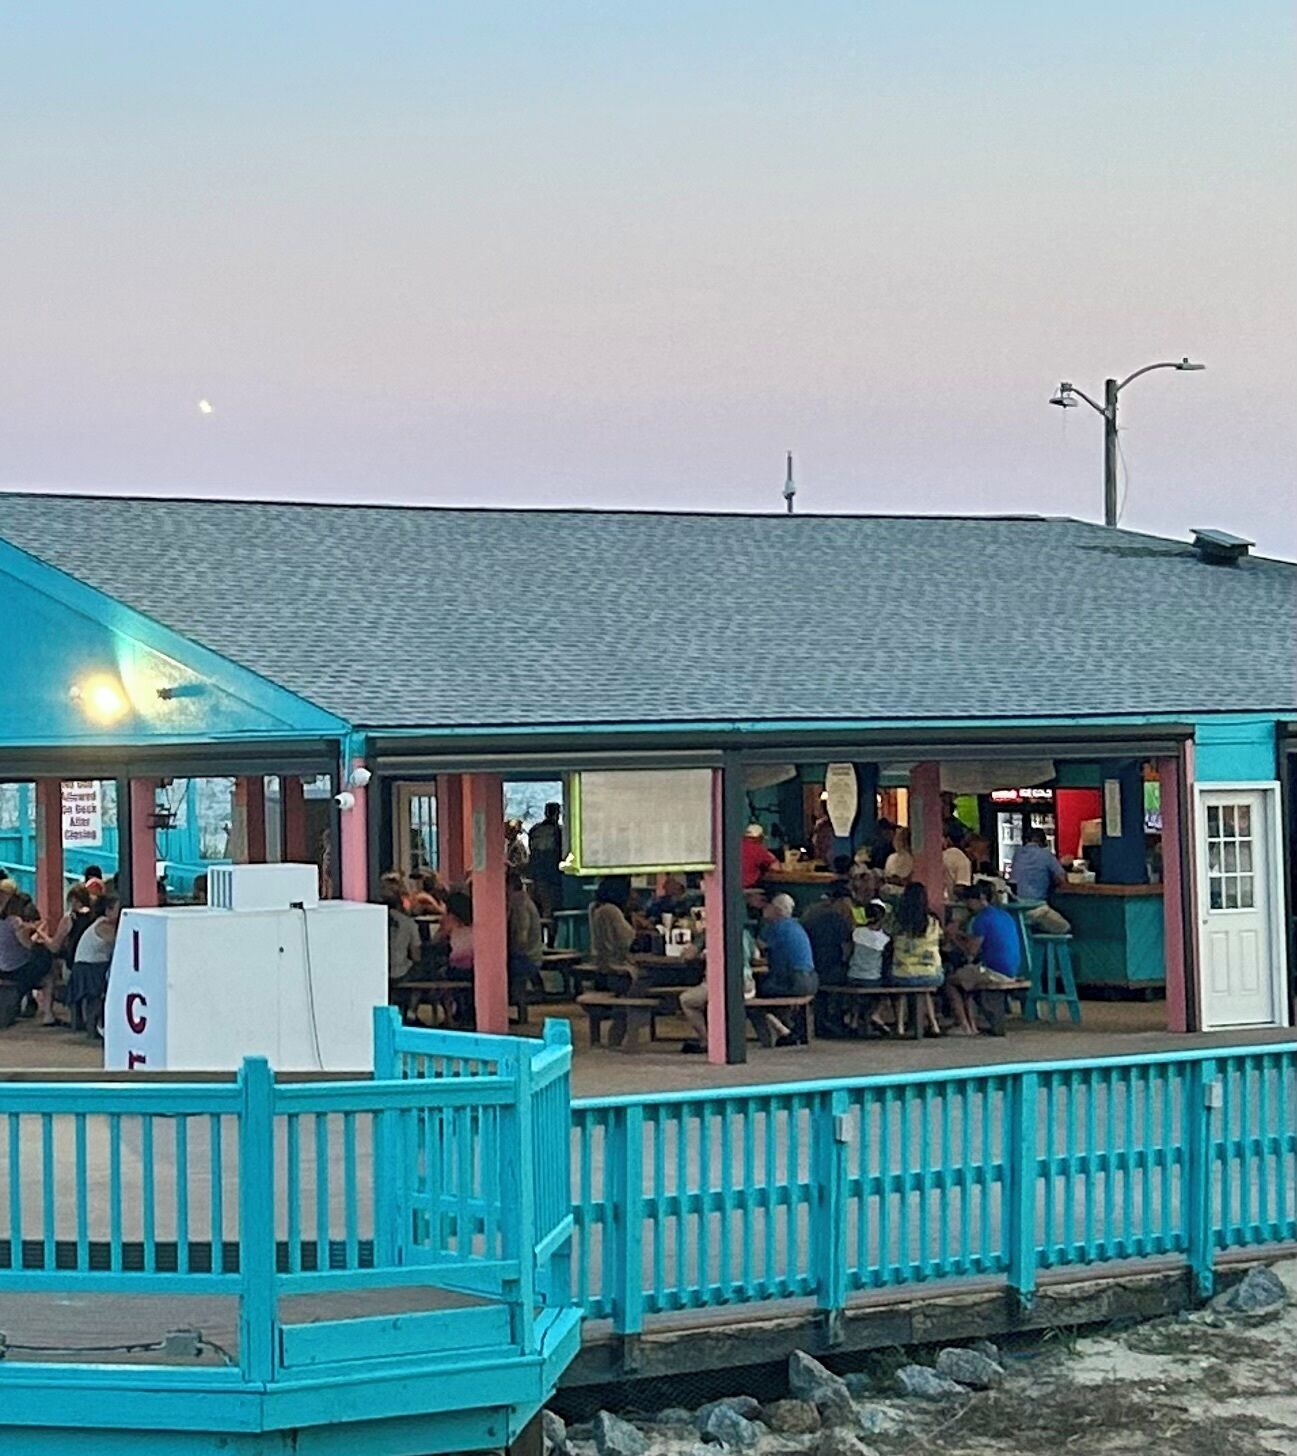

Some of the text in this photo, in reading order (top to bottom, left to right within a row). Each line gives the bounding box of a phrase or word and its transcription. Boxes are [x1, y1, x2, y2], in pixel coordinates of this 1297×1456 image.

[76, 803, 97, 814] Deck
[70, 816, 90, 827] After
[64, 829, 97, 840] Closing
